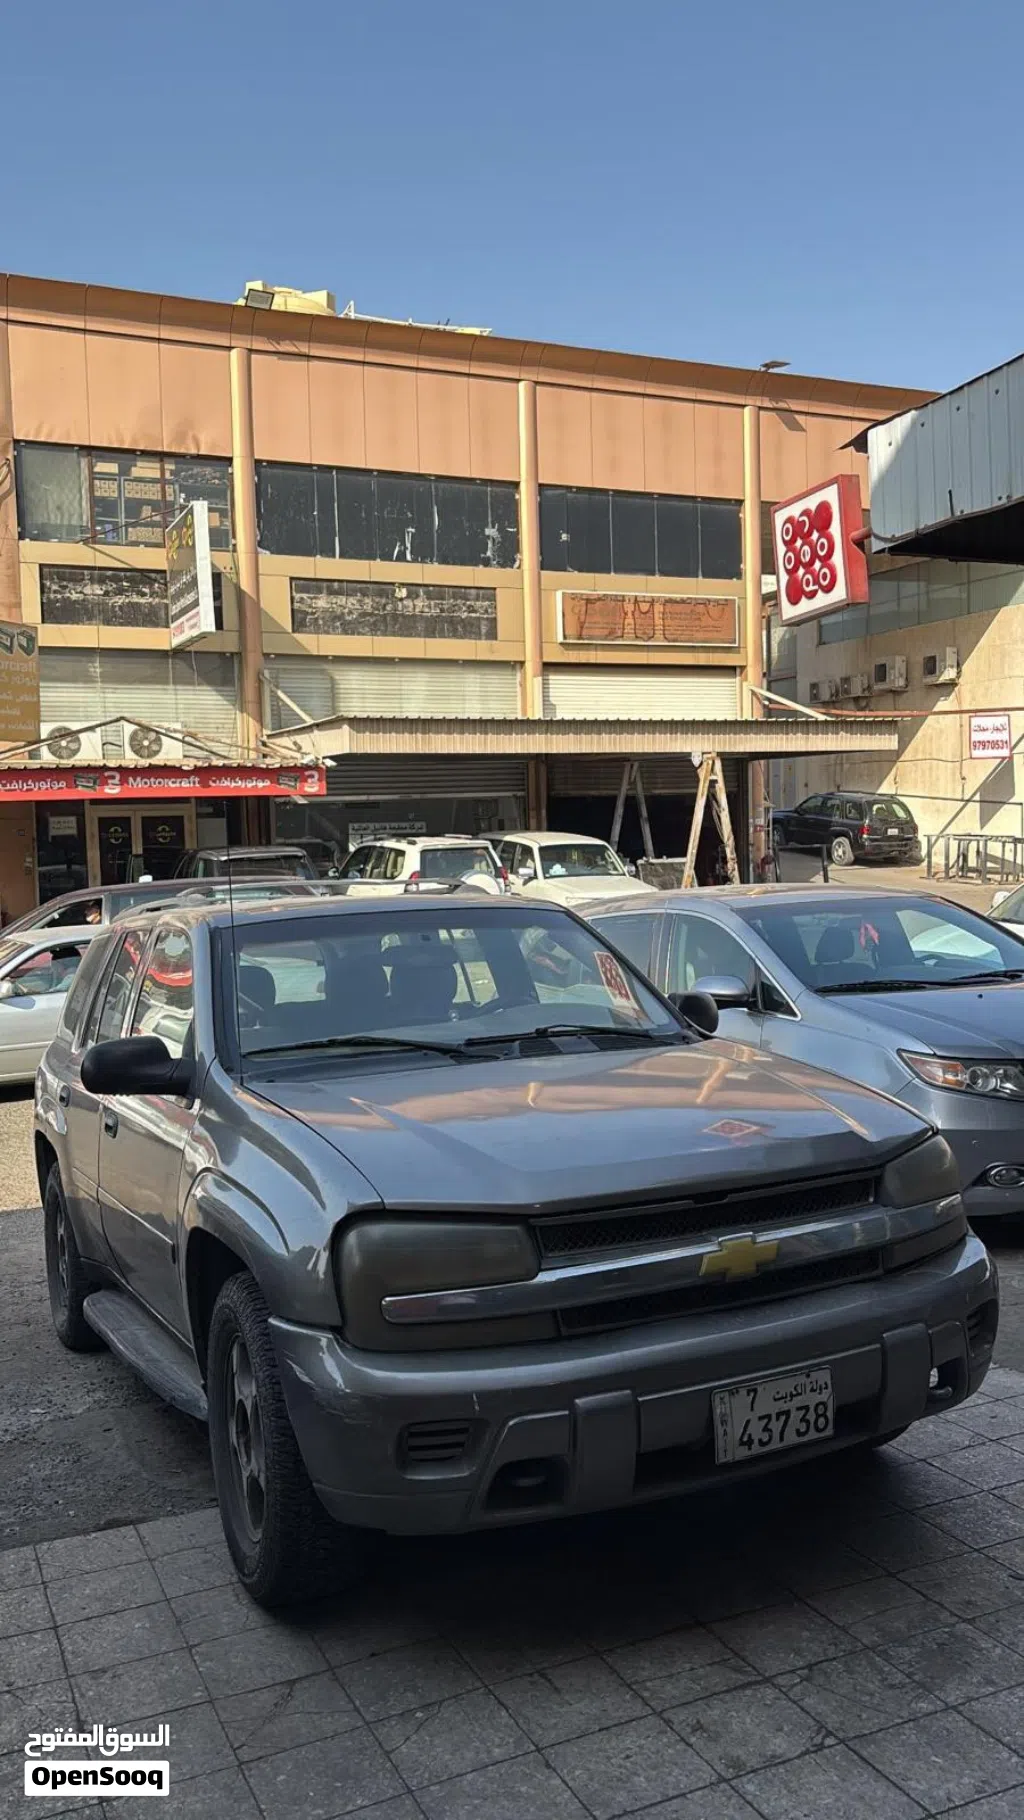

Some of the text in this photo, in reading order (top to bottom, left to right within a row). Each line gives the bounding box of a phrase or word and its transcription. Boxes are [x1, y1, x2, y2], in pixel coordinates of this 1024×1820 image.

[973, 740, 1009, 751] 97970531
[128, 776, 200, 789] Motorcraft
[208, 776, 271, 789] موتوركرافت
[746, 1387, 758, 1412] 7
[772, 1379, 829, 1404] دولة الكويت
[738, 1401, 830, 1451] 43738
